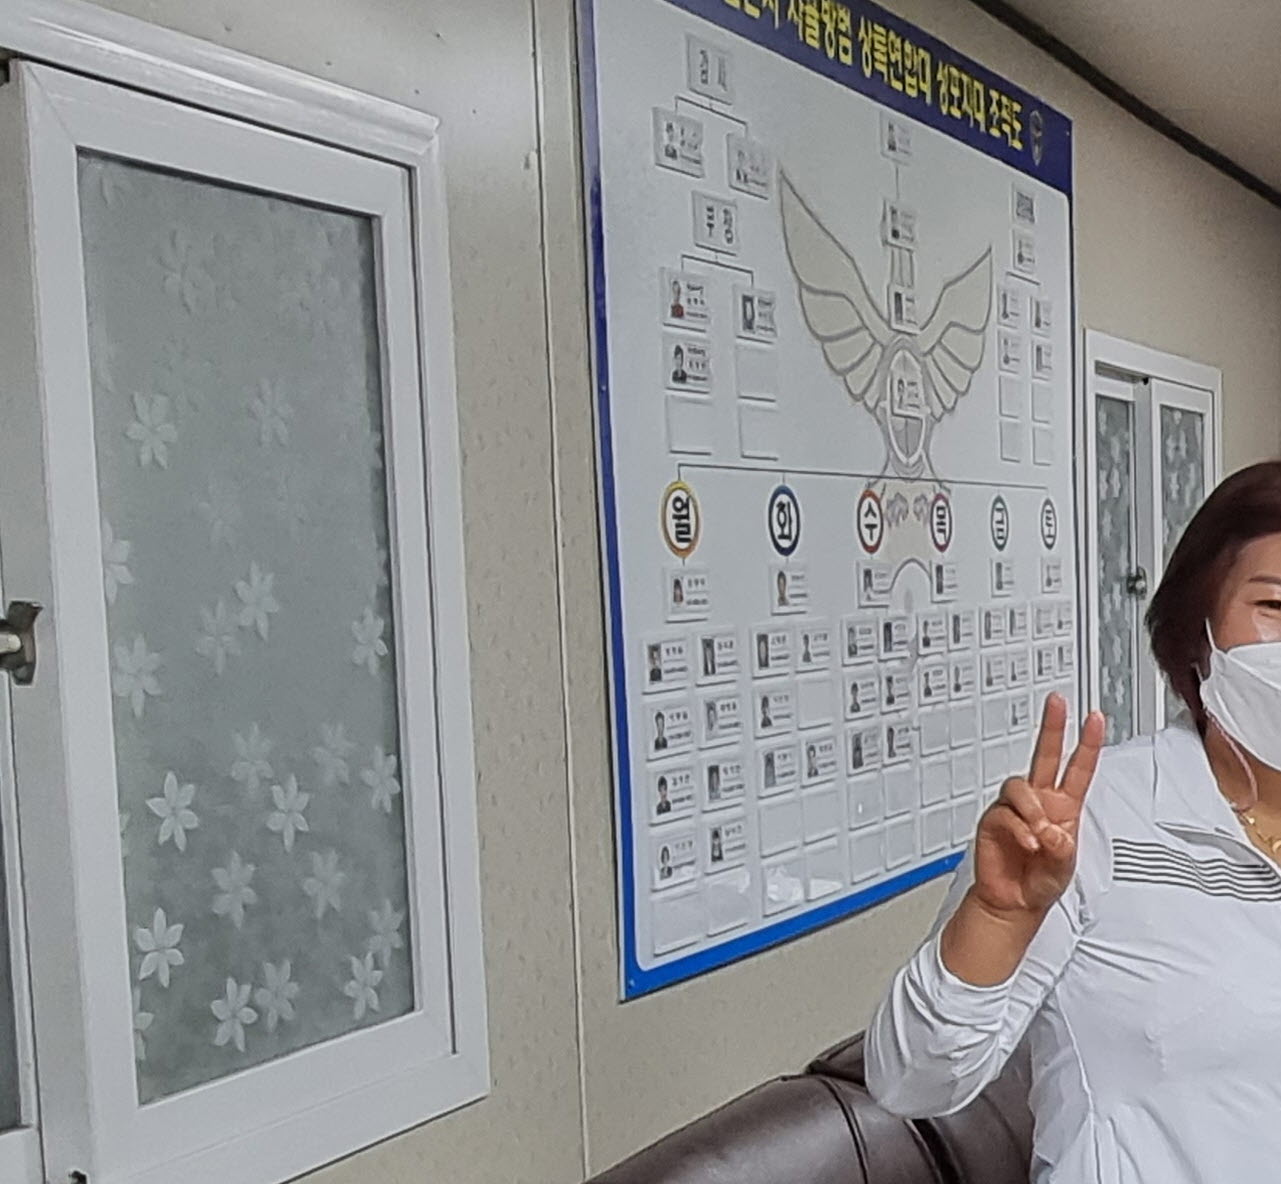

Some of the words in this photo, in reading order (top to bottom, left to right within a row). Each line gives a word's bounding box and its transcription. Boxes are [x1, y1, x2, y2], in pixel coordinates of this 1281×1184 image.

[858, 16, 932, 106] 상록연합대
[863, 501, 878, 542] 수
[935, 505, 948, 545] 목
